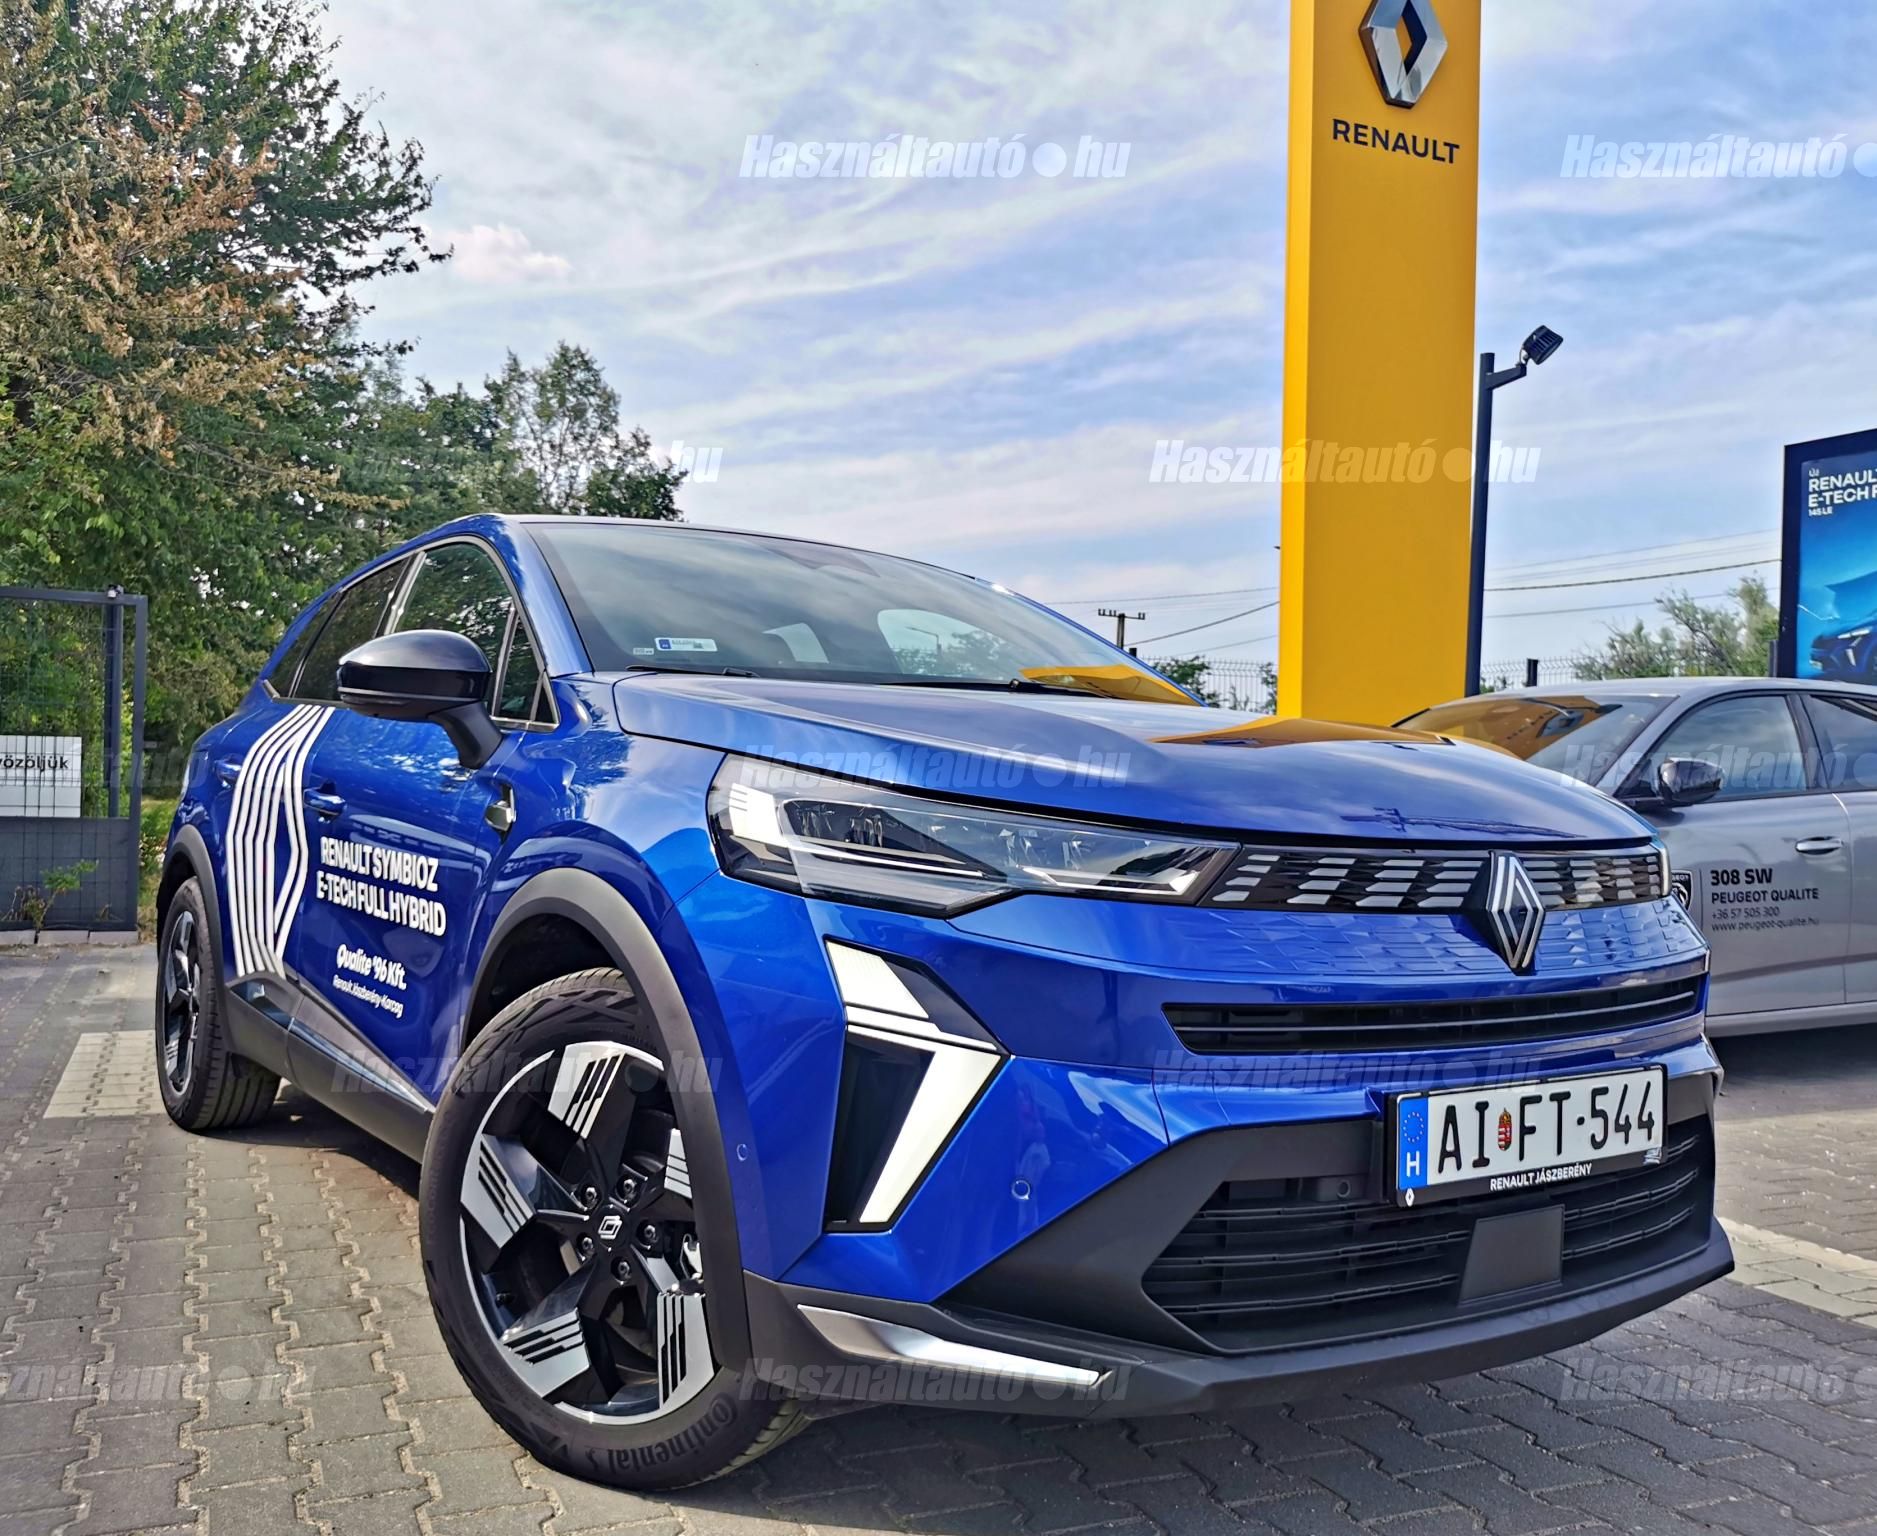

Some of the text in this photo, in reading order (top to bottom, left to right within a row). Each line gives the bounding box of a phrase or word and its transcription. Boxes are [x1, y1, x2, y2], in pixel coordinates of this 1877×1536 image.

[1333, 118, 1460, 164] RENAULT
[1808, 469, 1877, 492] RENAUL
[1808, 486, 1869, 508] E-TECH
[0, 755, 69, 772] özöljük
[320, 836, 439, 892] RENAULT SYMBIOZ
[1710, 868, 1773, 886] 308 SW
[316, 870, 447, 936] E-TECH FULL HYBRID
[1711, 888, 1819, 904] PEUGEOT QUALITE
[1712, 908, 1728, 920] +36
[1730, 908, 1742, 918] 57
[1744, 907, 1761, 918] 505
[1406, 1150, 1420, 1178] H
[1490, 1162, 1593, 1191] RENAULT JÁSZBERÉNY
[606, 1390, 739, 1475] Continental
